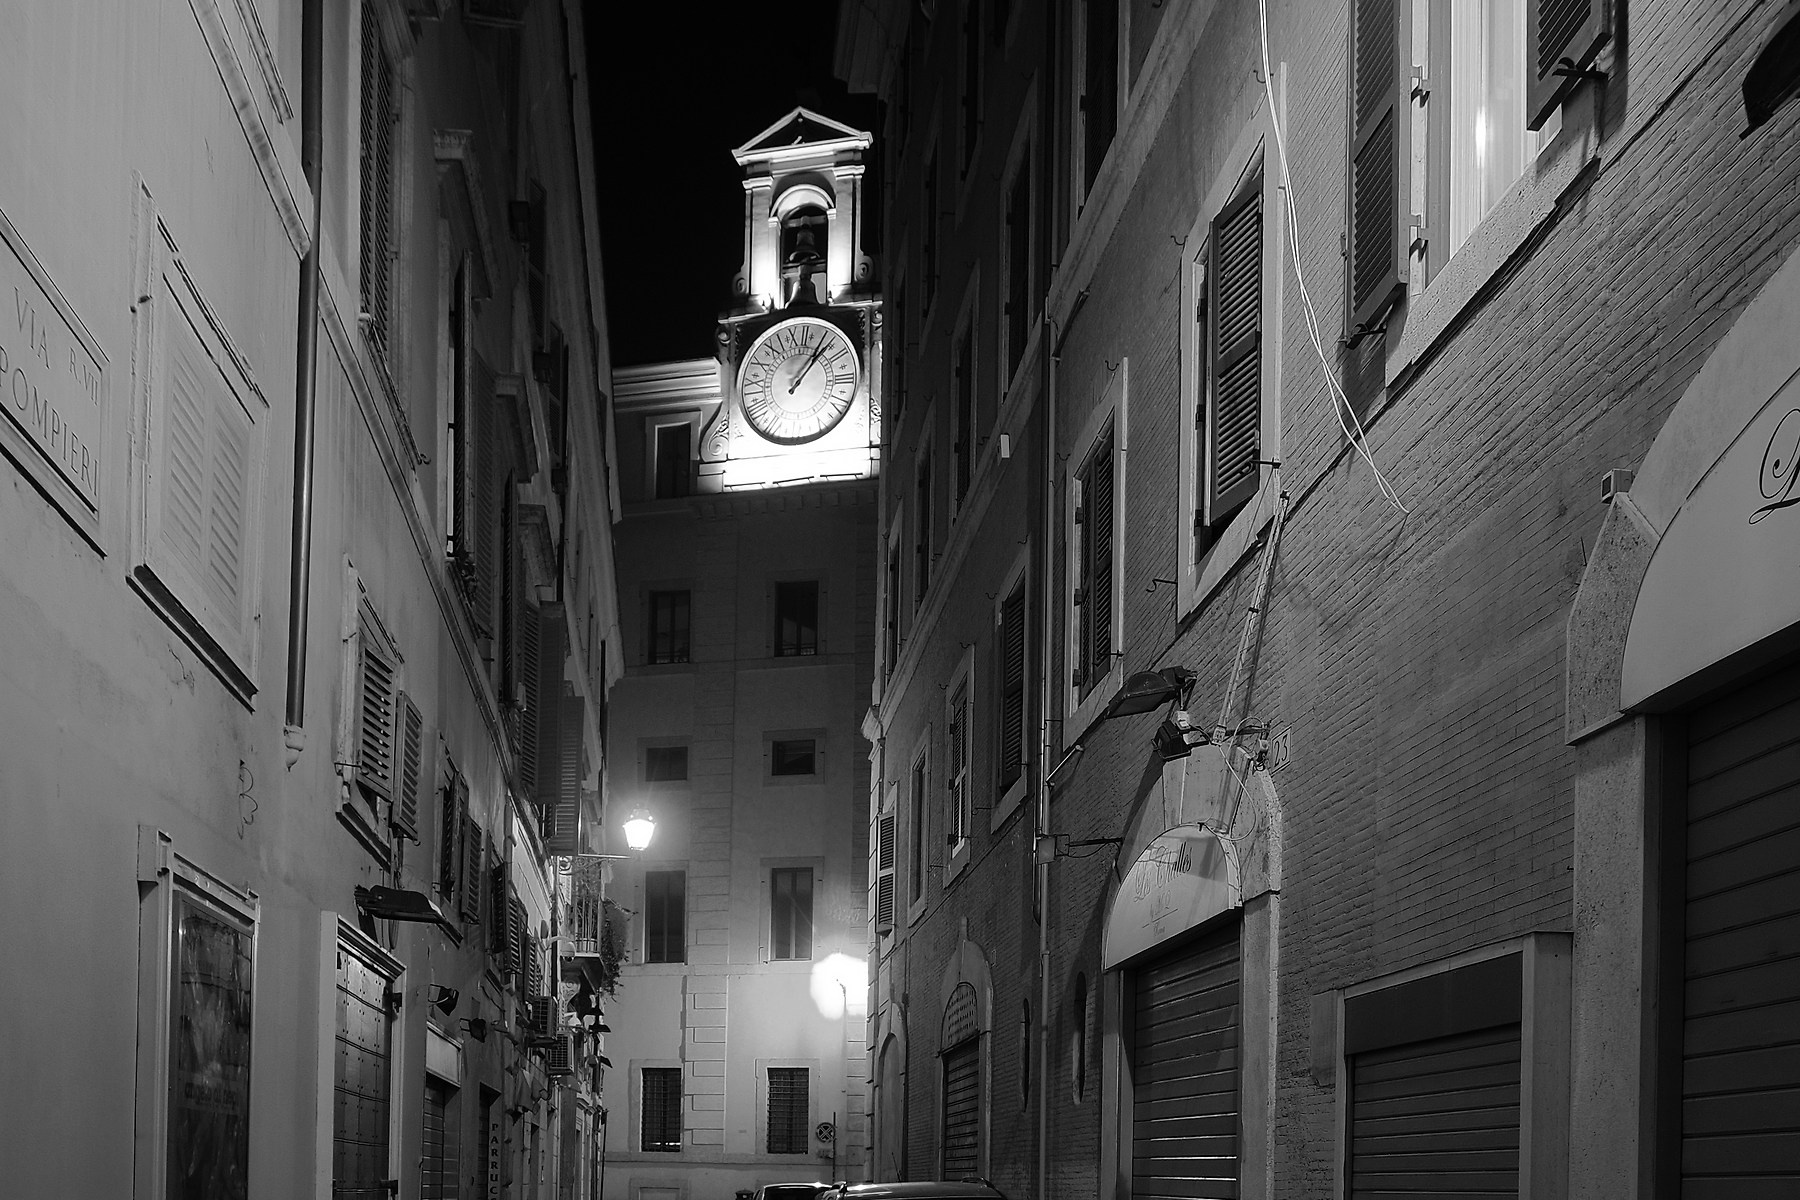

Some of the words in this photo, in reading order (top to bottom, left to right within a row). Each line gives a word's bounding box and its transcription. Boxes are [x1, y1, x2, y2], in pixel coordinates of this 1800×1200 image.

[14, 286, 50, 369] VIA
[0, 346, 98, 496] POMPIERI
[1273, 733, 1288, 768] 23
